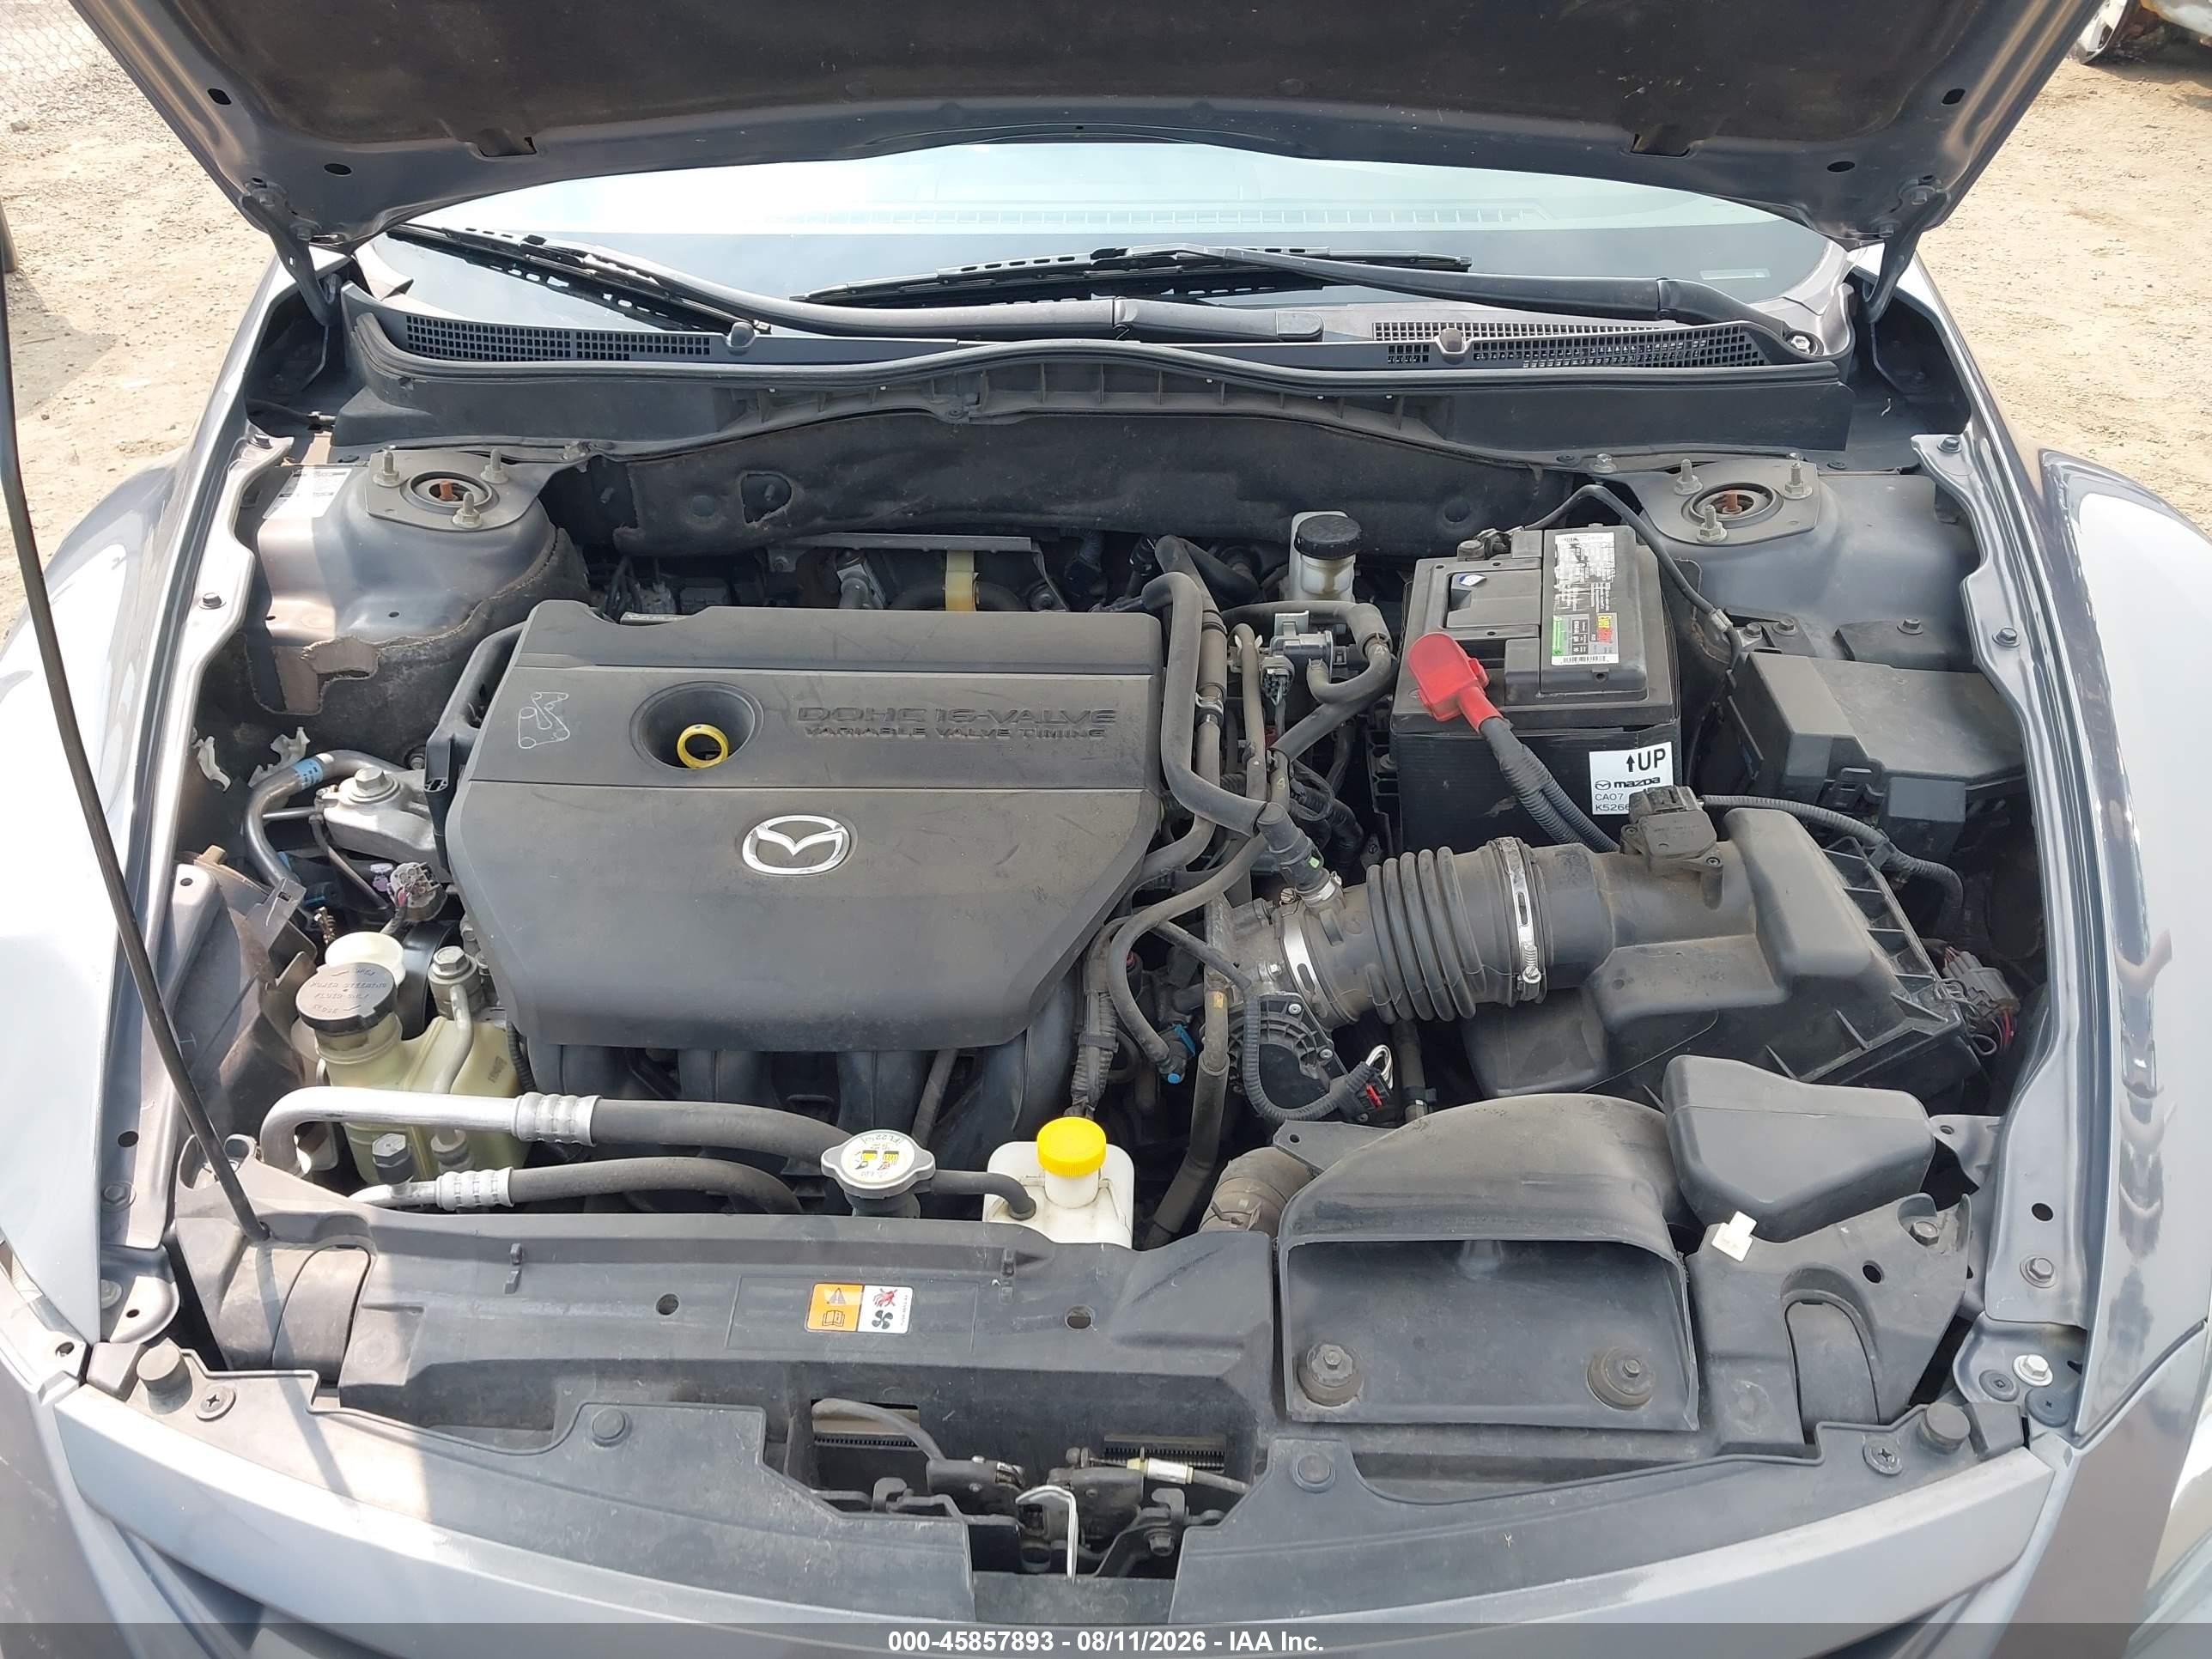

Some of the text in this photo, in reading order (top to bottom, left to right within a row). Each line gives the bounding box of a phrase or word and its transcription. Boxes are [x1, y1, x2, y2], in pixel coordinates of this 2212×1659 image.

[797, 707, 1117, 726] DOHC 16-VALVE
[805, 727, 1108, 740] VARIABLE VALVE TIMING
[1638, 748, 1666, 771] UP
[1613, 777, 1661, 788] mazda
